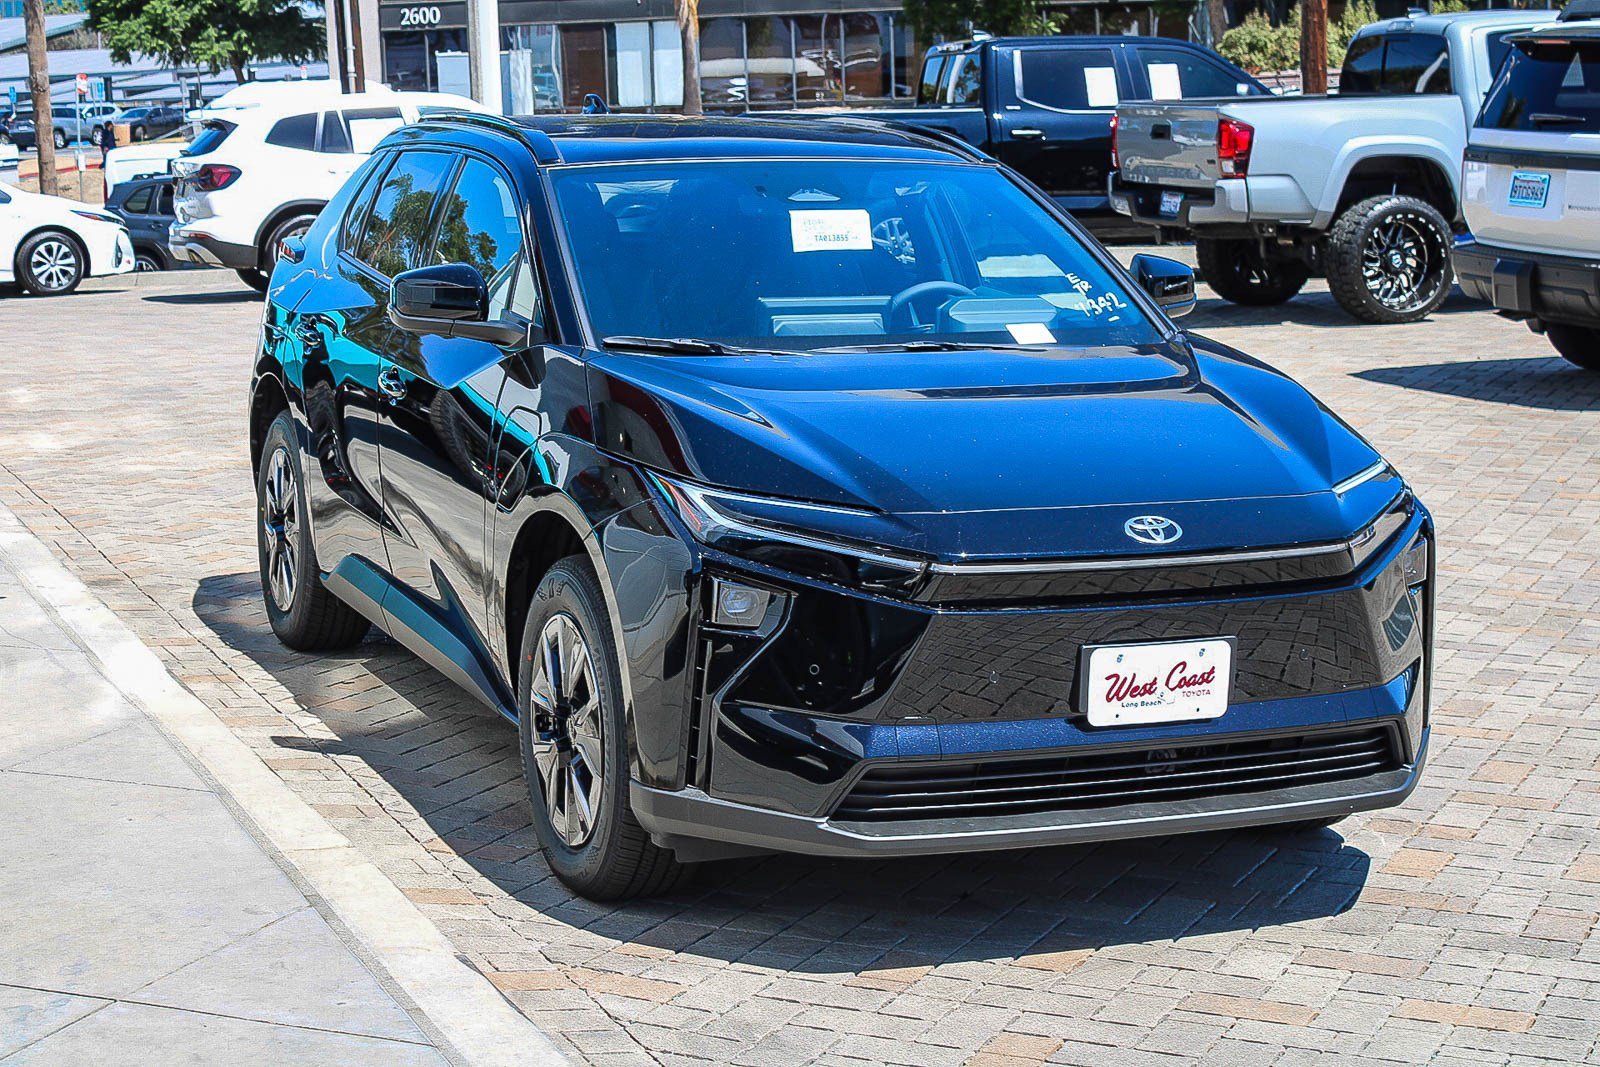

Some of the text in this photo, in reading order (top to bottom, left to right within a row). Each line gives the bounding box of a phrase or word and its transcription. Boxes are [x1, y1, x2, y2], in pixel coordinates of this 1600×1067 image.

[400, 6, 441, 25] 2600
[1105, 660, 1216, 703] West Coast
[1181, 688, 1211, 698] TOYOTA
[1121, 699, 1162, 709] Long Beach
